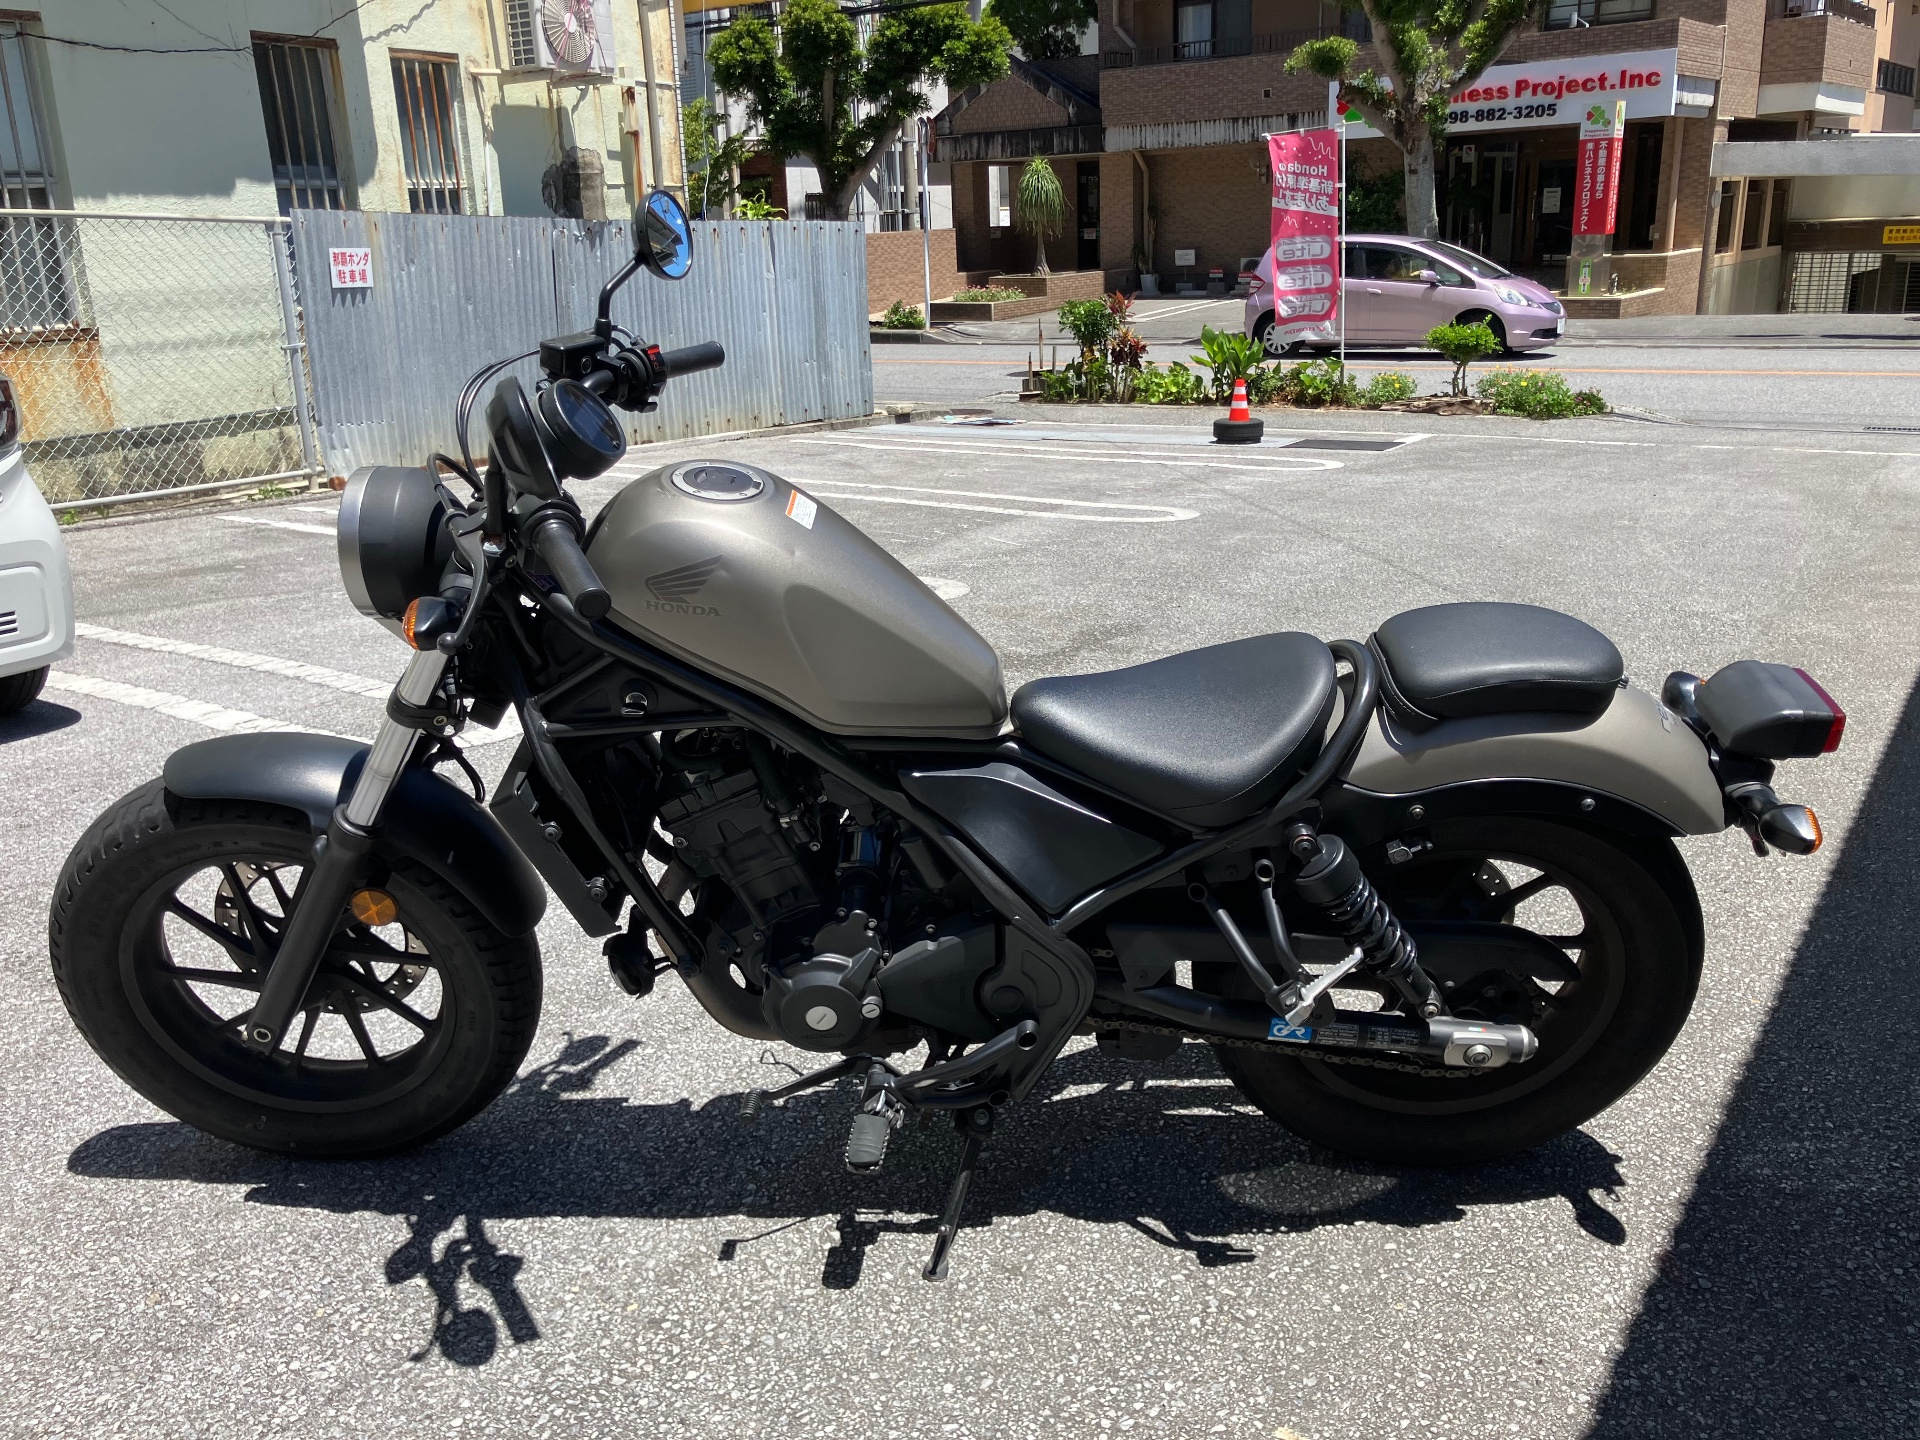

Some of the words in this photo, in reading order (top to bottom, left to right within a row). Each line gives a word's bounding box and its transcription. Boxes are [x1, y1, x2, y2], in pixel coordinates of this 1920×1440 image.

[1514, 69, 1662, 100] Project.Inc
[332, 251, 370, 267] 那覇ホンダ
[337, 269, 368, 284] 駐車場
[645, 600, 722, 616] HONDA
